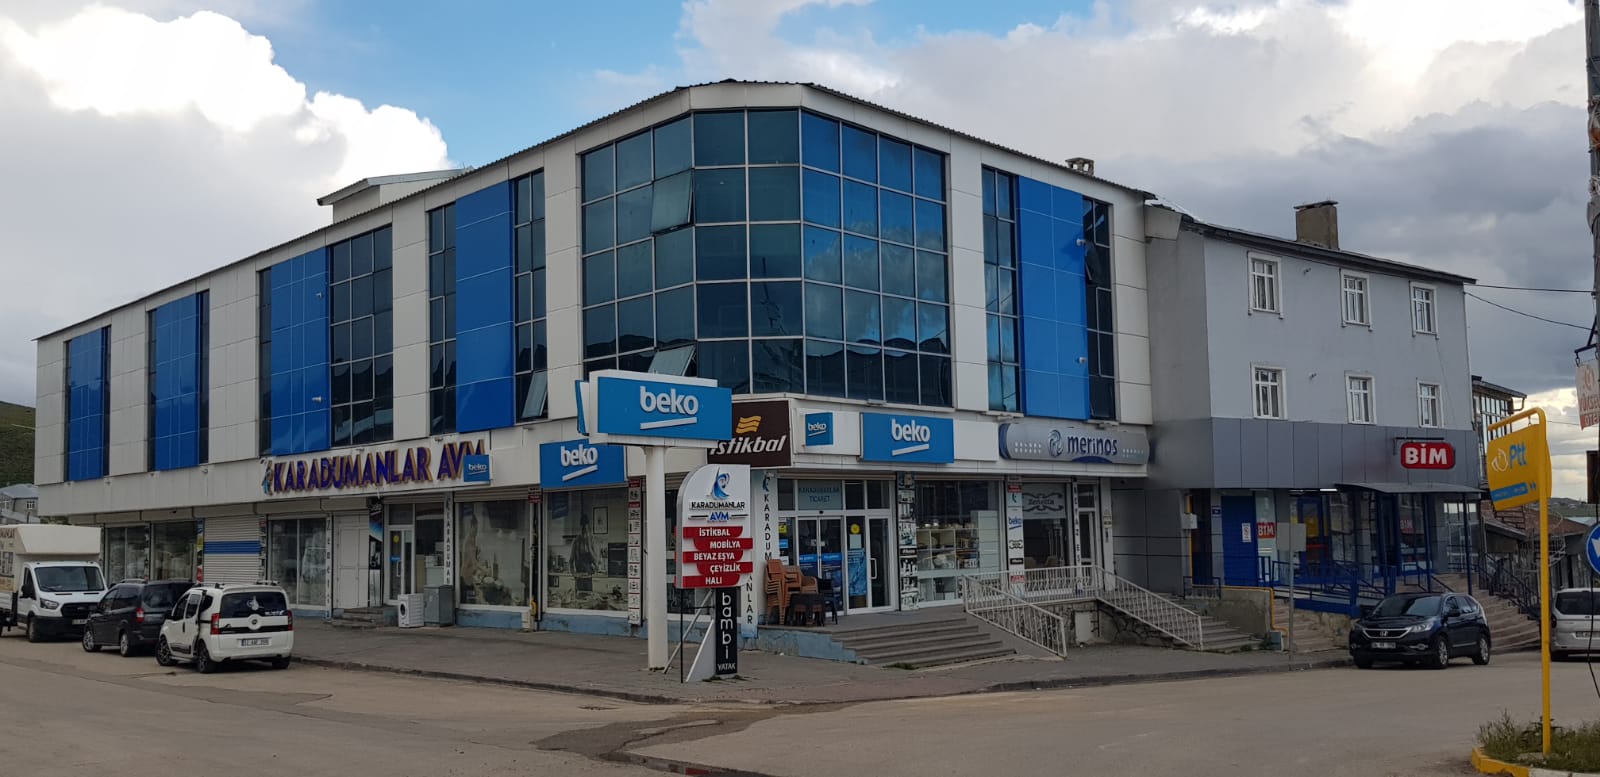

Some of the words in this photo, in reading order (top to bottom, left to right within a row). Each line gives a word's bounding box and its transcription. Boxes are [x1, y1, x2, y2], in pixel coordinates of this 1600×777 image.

[640, 386, 699, 415] beko
[808, 422, 826, 431] beko
[891, 419, 931, 442] beko
[1067, 435, 1118, 456] merinos
[560, 443, 598, 467] beko
[1405, 443, 1448, 465] BİM
[1509, 441, 1528, 469] Ptt
[273, 446, 433, 493] KARADUMANLAR
[468, 462, 487, 472] beko
[690, 501, 746, 510] KARADUMANLAR
[709, 511, 730, 522] AVM
[698, 527, 731, 537] İSTİKBAL
[709, 539, 741, 549] MOBİLYA
[693, 552, 717, 561] BEYAZ
[717, 551, 735, 562] EŞYA
[709, 563, 741, 574] ÇEYİZLİK
[705, 576, 723, 585] HALI
[720, 592, 733, 659] bambi
[717, 663, 736, 672] YATAK
